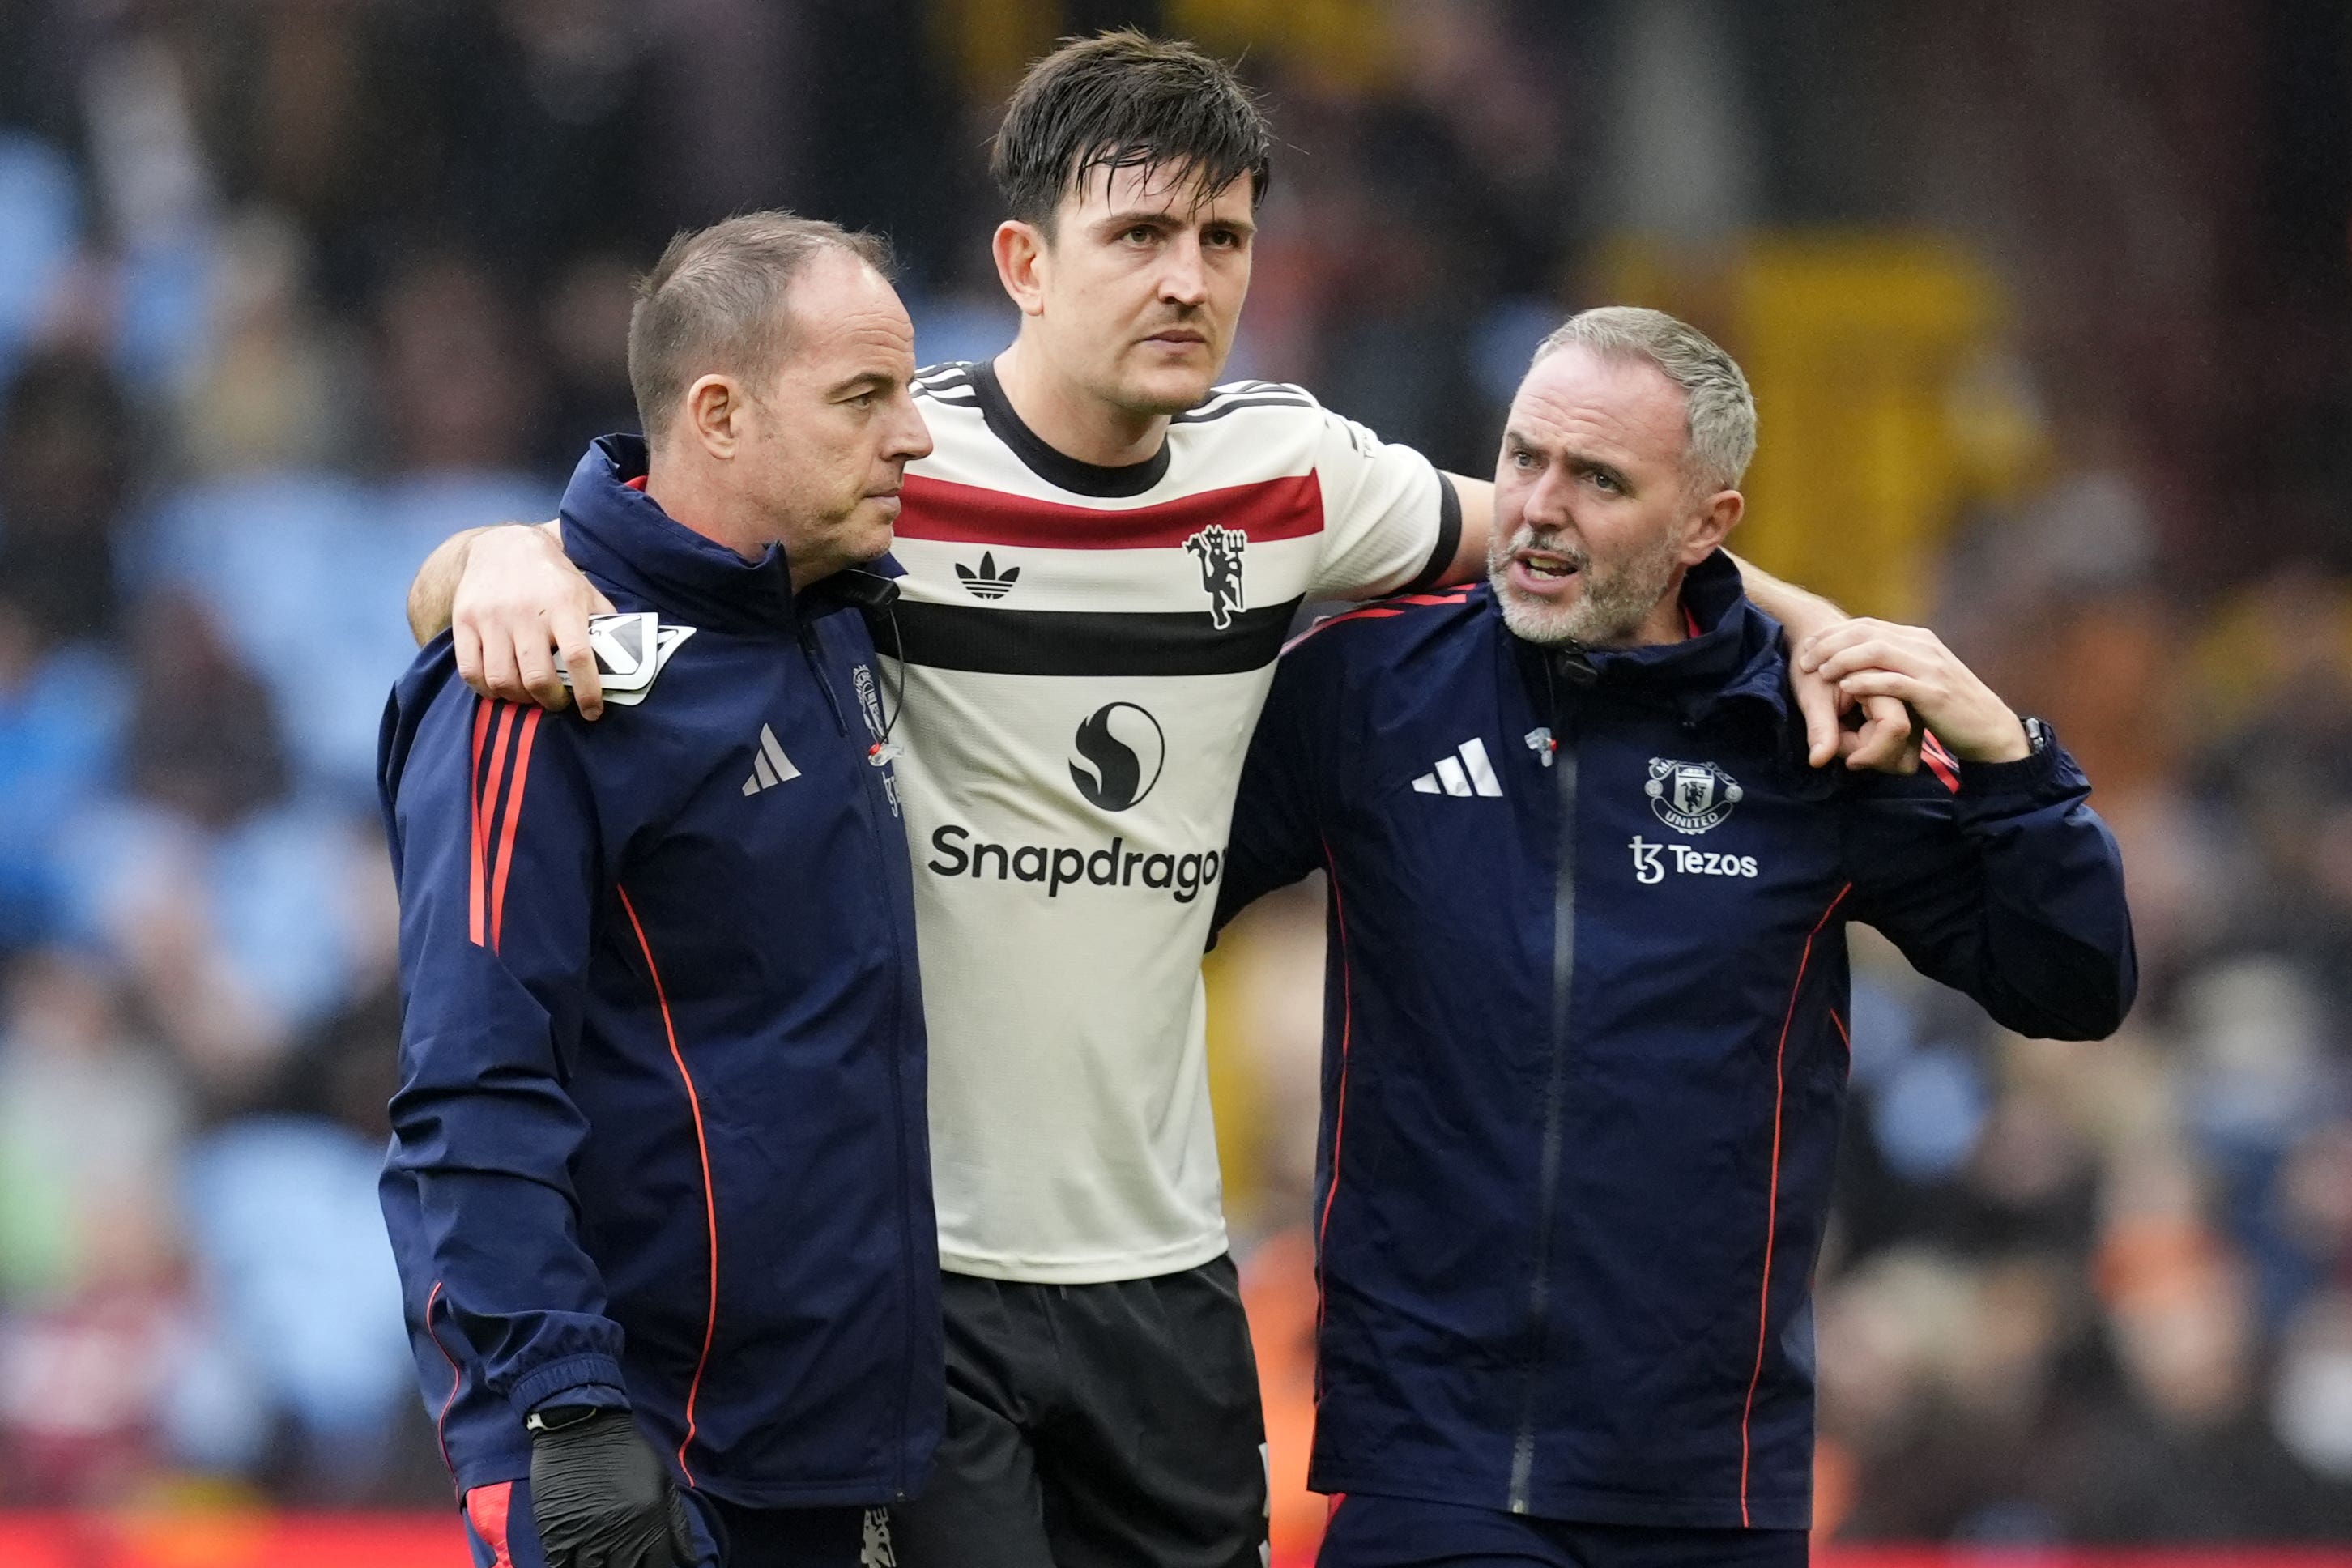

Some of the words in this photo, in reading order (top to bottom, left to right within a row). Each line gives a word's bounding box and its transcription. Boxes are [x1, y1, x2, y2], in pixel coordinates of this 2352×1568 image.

[1665, 811, 1719, 829] UNITED
[928, 825, 1227, 903] Snapdrago
[1668, 844, 1758, 878] Tezos
